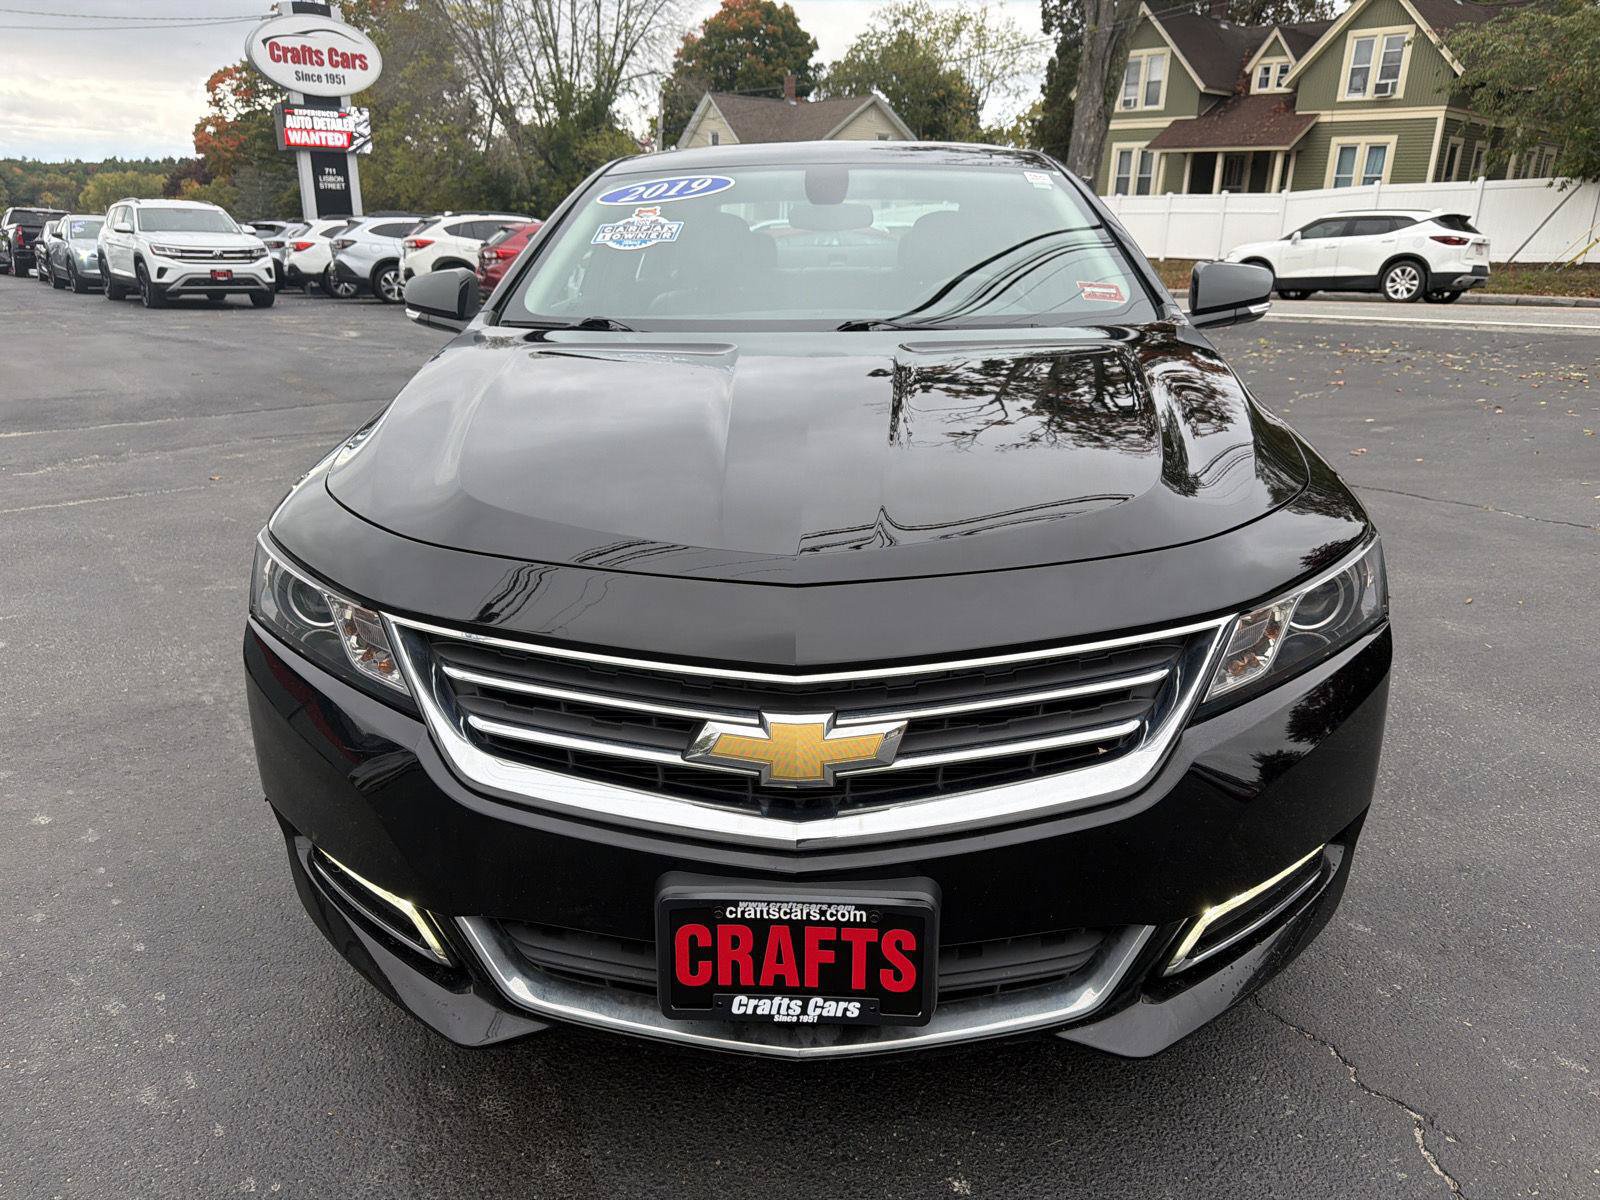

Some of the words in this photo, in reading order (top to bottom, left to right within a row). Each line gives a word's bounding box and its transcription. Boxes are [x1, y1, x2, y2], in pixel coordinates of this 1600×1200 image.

[268, 40, 325, 67] Crafts
[327, 46, 369, 71] Cars
[294, 70, 322, 83] Since
[324, 72, 346, 85] 1951
[285, 115, 312, 129] AUTO
[313, 117, 355, 132] DETAILER
[287, 130, 348, 146] WANTED!
[318, 175, 344, 183] LISBON
[324, 167, 336, 175] 711
[319, 182, 346, 190] STREET
[617, 178, 713, 202] 2019
[612, 232, 672, 240] OWNER
[725, 905, 867, 922] craftscars.com
[674, 923, 917, 993] CRAFTS
[731, 995, 802, 1015] Crafts
[807, 997, 861, 1017] Cars
[773, 1014, 797, 1022] Since
[799, 1014, 818, 1023] 1951
